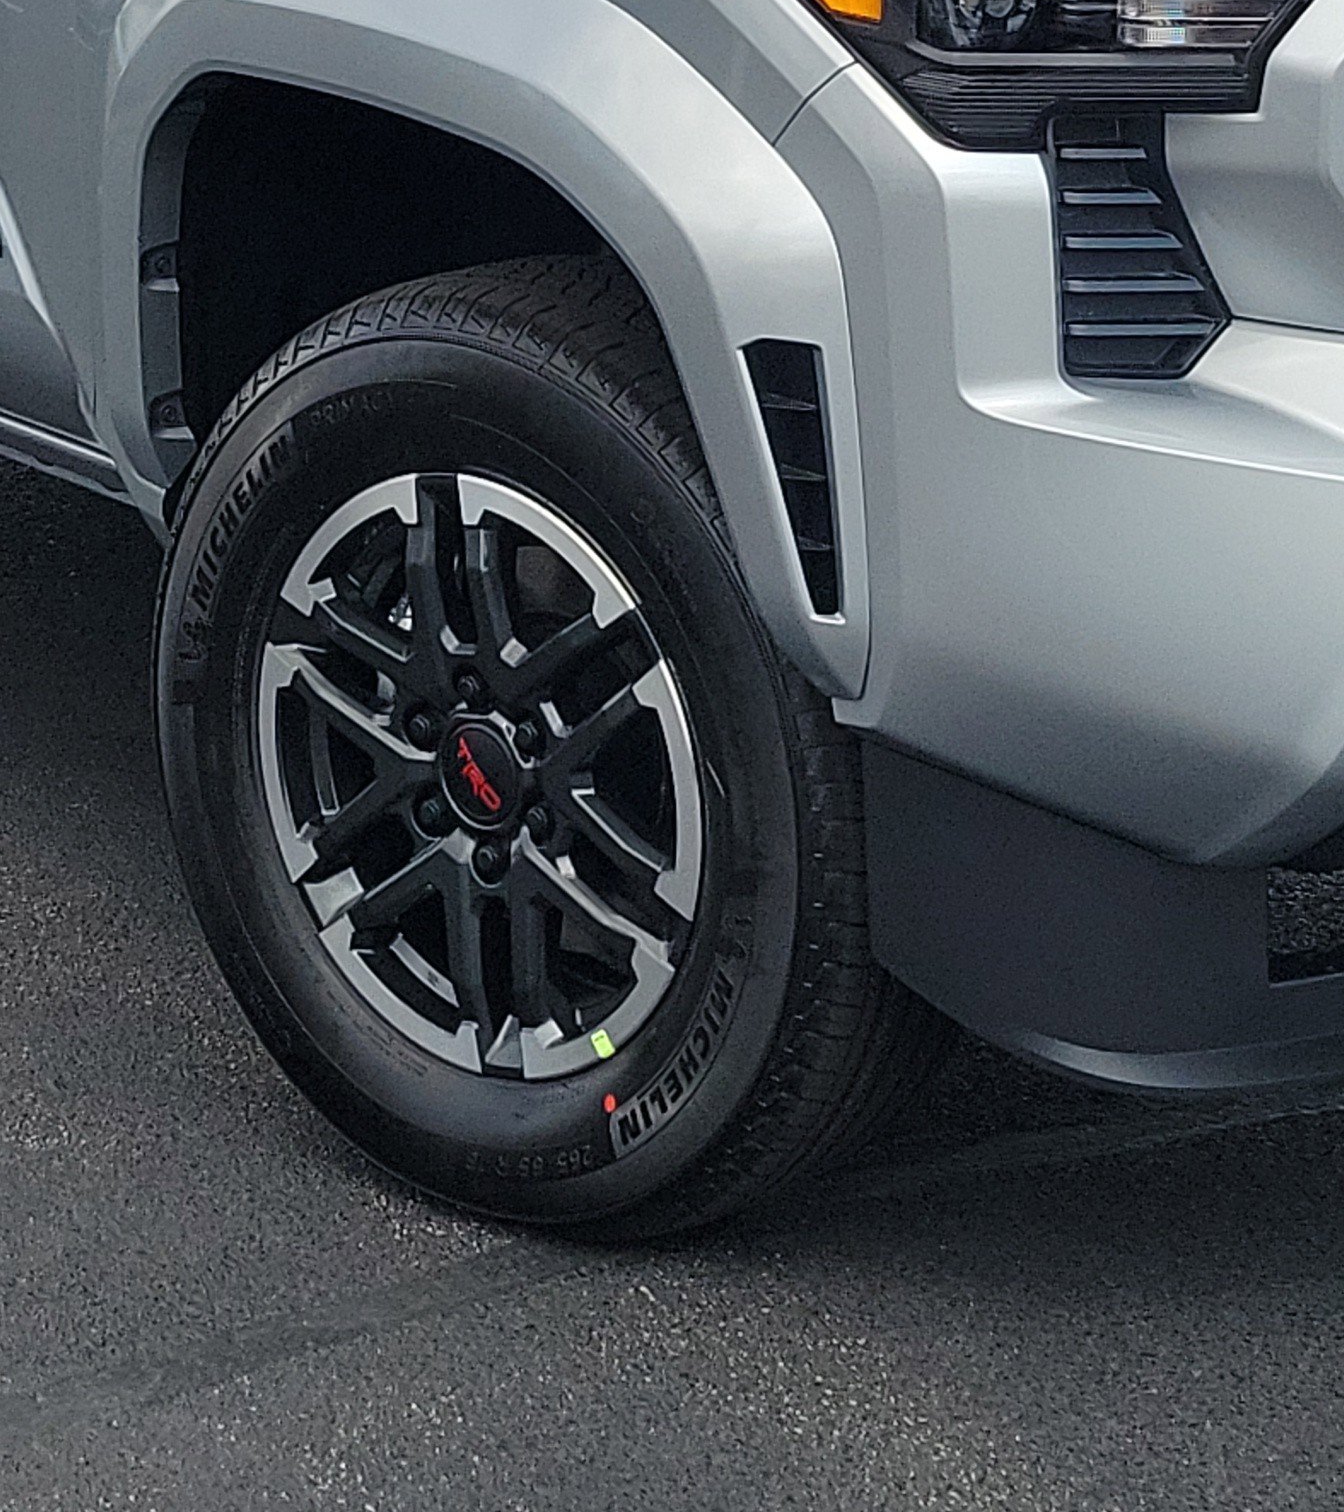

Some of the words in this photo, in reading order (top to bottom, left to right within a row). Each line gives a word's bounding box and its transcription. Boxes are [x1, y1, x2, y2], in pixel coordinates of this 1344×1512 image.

[189, 433, 290, 612] MICHELIN
[457, 737, 501, 812] TRD
[617, 970, 735, 1146] MICHELIN
